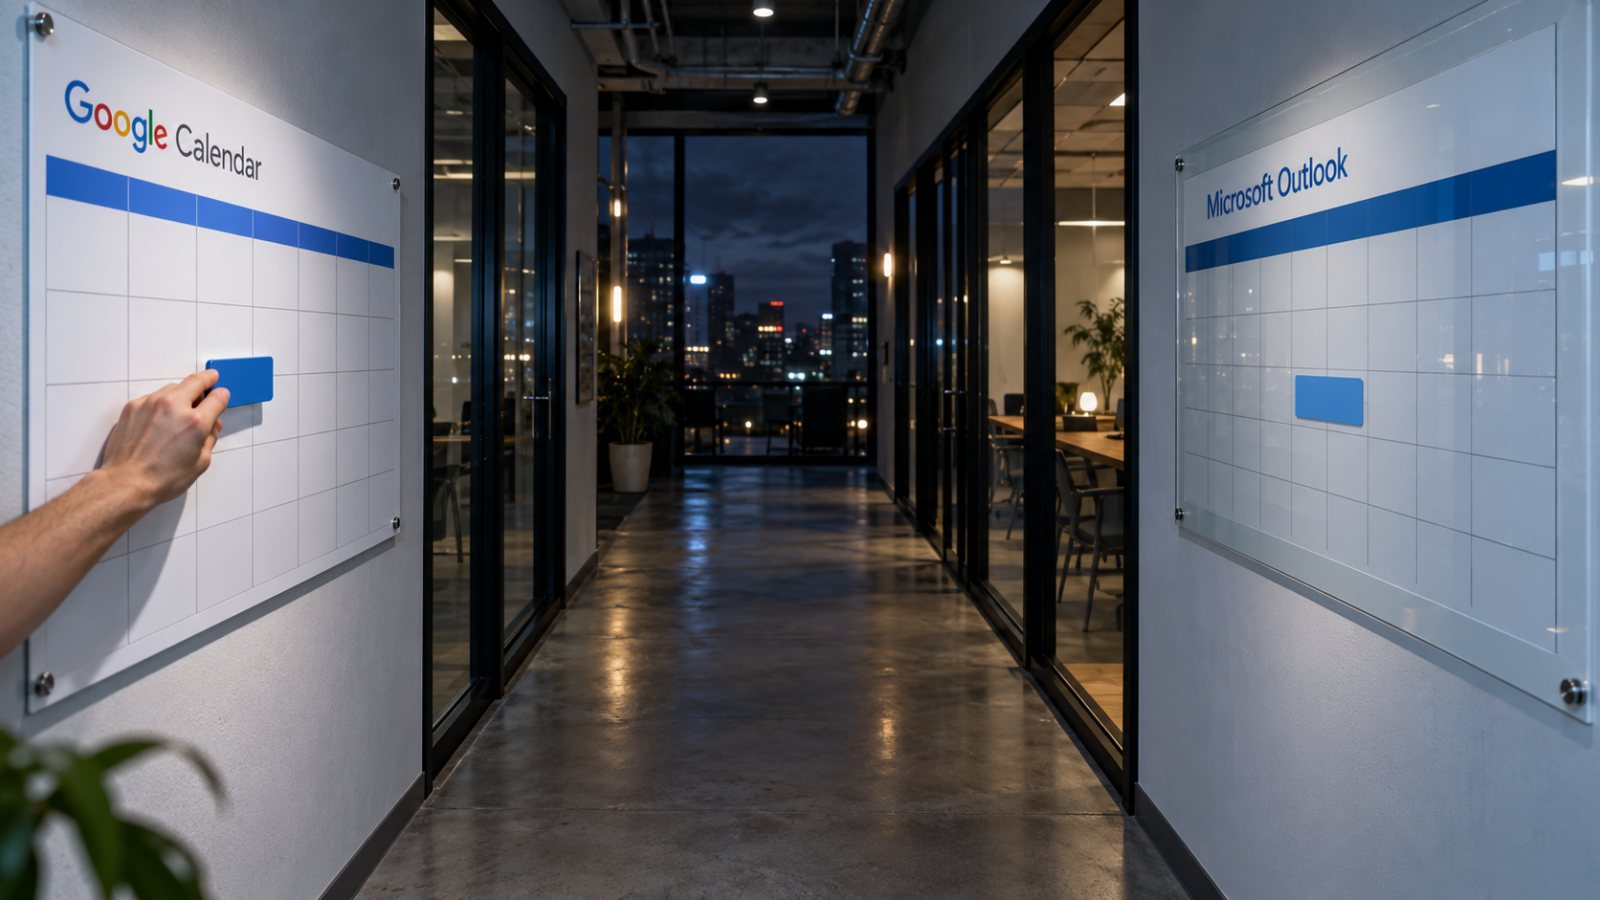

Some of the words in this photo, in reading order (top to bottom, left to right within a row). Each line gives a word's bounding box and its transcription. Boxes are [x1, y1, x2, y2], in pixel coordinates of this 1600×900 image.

[64, 79, 168, 154] Google
[175, 123, 262, 180] Calendar
[1207, 172, 1273, 220] Microsoft
[1277, 147, 1348, 197] Outlook
